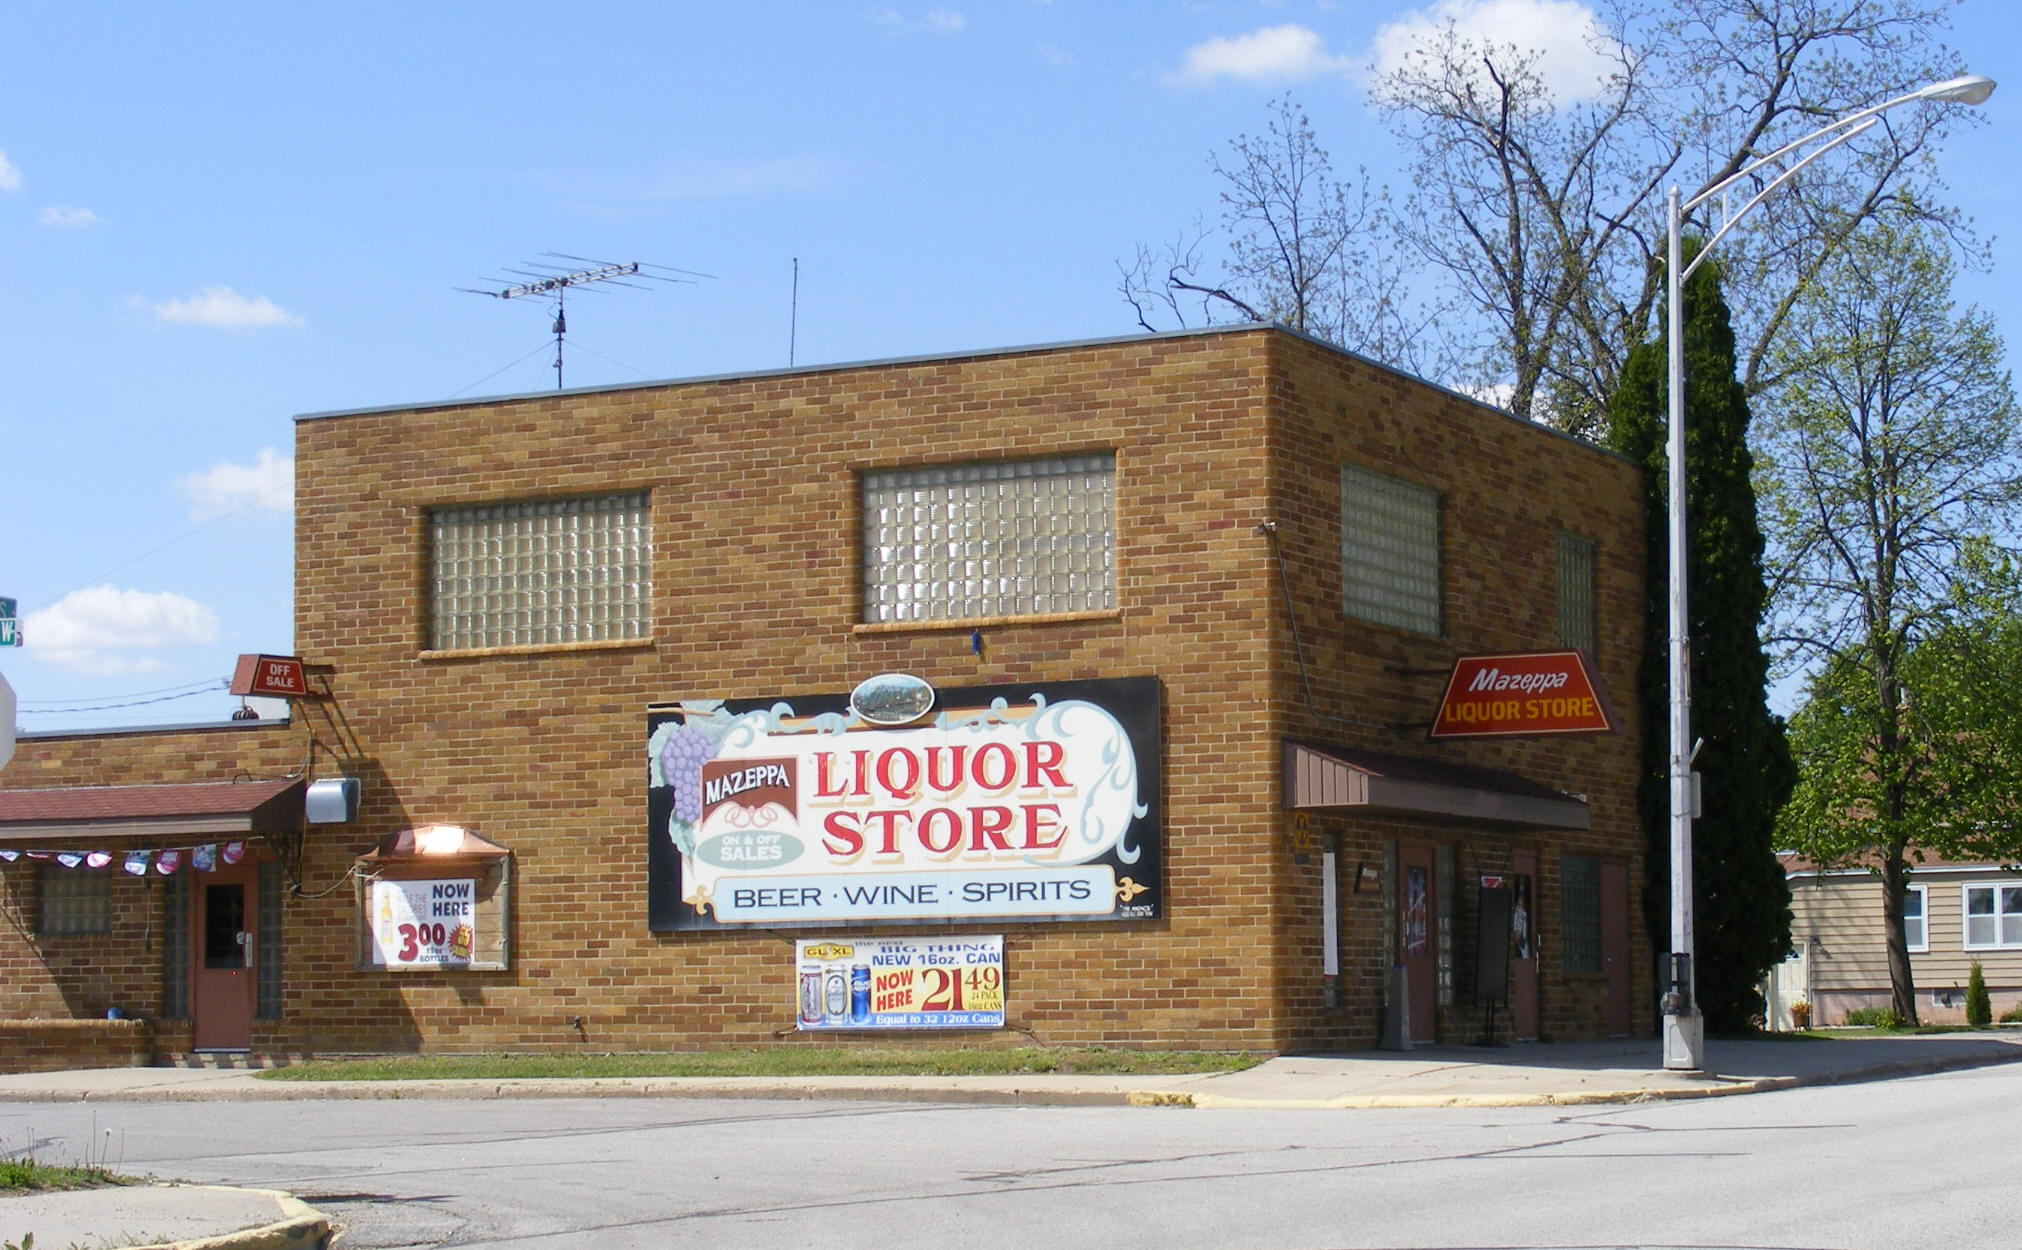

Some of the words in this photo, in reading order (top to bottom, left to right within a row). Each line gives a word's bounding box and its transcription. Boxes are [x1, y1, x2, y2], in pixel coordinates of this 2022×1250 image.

[270, 664, 290, 675] OFF
[266, 675, 294, 688] SALE
[1468, 668, 1568, 694] Mazeppa
[1445, 701, 1520, 724] LIQUOR
[1526, 697, 1595, 719] STORE
[812, 741, 1075, 800] LIQUOR
[705, 764, 791, 805] MAZEPPA
[821, 803, 1068, 856] STORE
[722, 836, 740, 845] ON
[744, 835, 753, 845] &
[757, 835, 782, 844] OFF
[720, 845, 782, 861] SALES
[432, 884, 470, 899] NOW
[733, 887, 822, 908] BEER
[843, 884, 939, 905] WINE
[962, 879, 1091, 902] SPIRITS
[433, 901, 469, 916] HERE
[880, 944, 917, 953] BIG
[927, 943, 995, 952] THING
[872, 955, 911, 966] NEW
[966, 952, 1000, 964] CAN
[876, 968, 913, 991] NOW
[876, 989, 912, 1012] HERE
[875, 1014, 906, 1025] Equal
[910, 1014, 921, 1024] to
[923, 1014, 939, 1024] 32
[971, 1012, 1000, 1024] Cans
